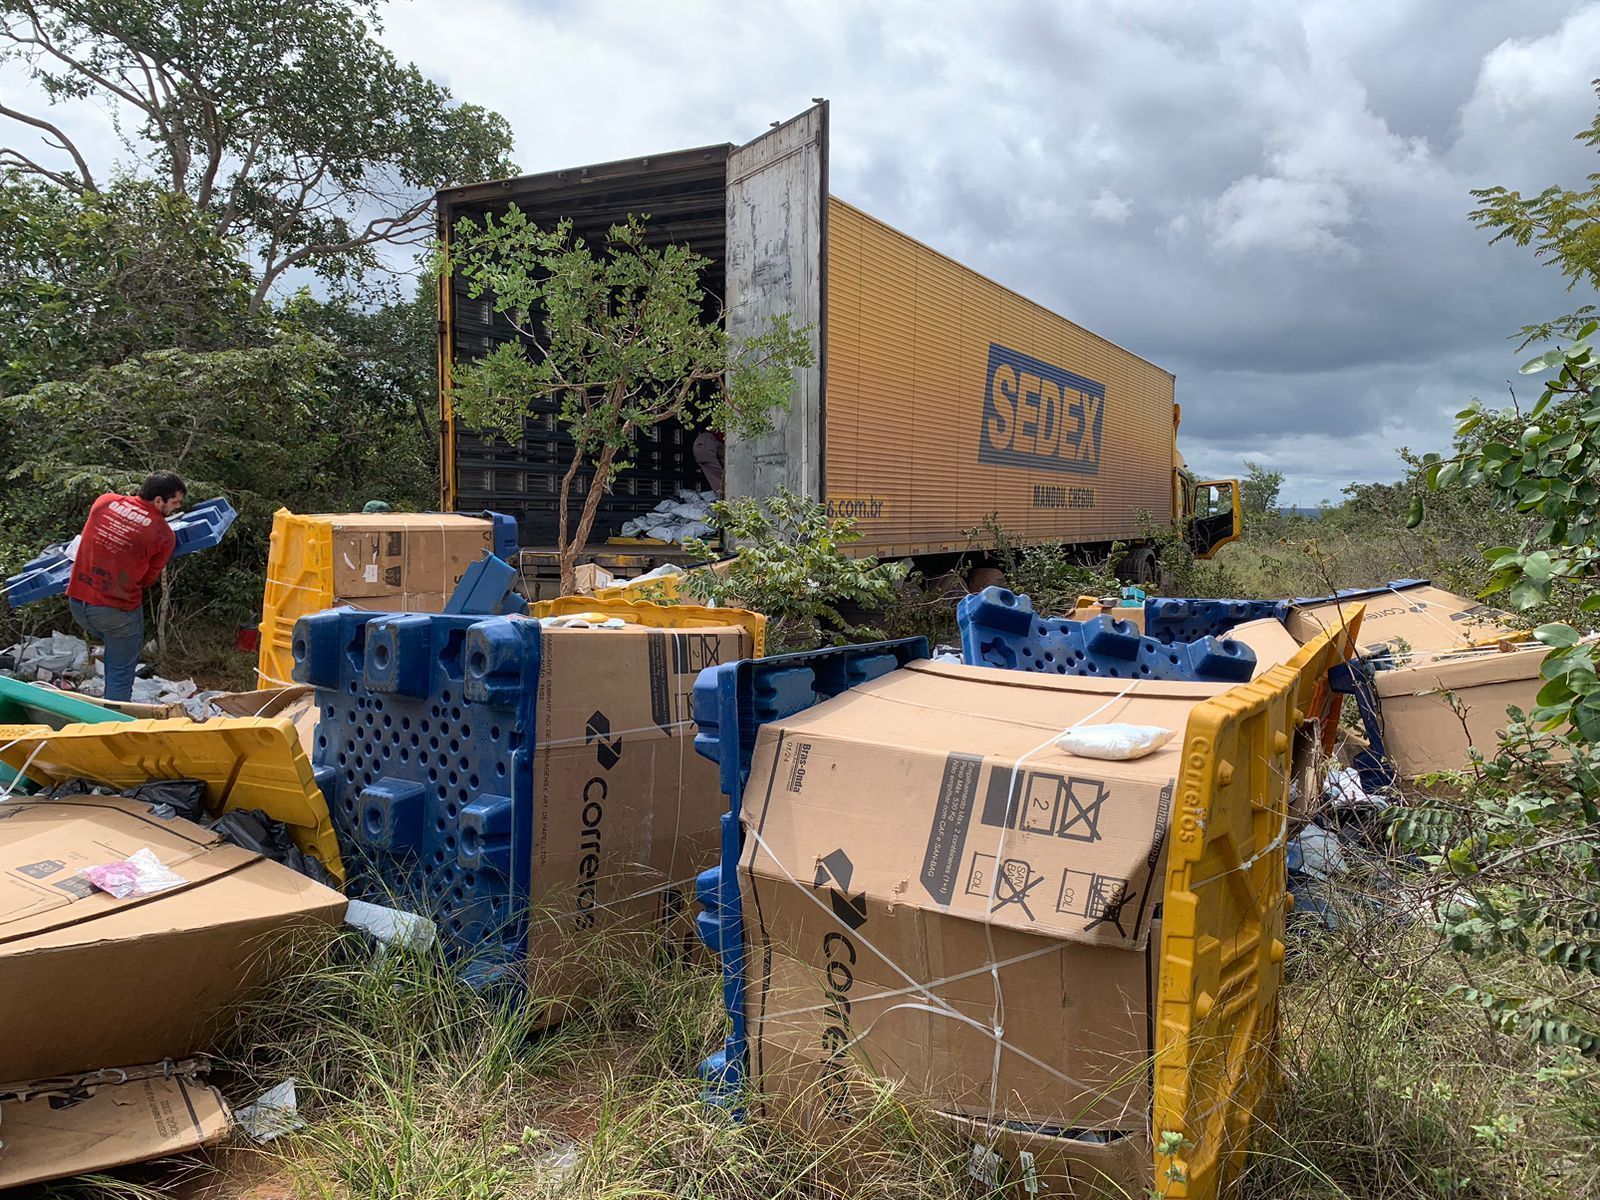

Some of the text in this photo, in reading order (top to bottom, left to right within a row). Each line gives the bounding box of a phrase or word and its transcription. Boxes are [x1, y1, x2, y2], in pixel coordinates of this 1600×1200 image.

[988, 363, 1100, 463] SEDEX
[784, 741, 793, 763] 01/24
[793, 743, 812, 793] Bras-Onda
[950, 760, 958, 774] Não
[958, 761, 967, 779] Peso
[943, 775, 955, 804] empilhar
[959, 761, 975, 810] Empilhamento
[1033, 797, 1049, 811] 2
[1156, 792, 1172, 828] alinhar
[947, 811, 956, 822] Kg
[937, 820, 946, 836] CAF
[575, 777, 608, 931] Correios
[971, 870, 983, 889] CDL
[1015, 865, 1026, 888] SAN
[1062, 887, 1074, 907] CDL
